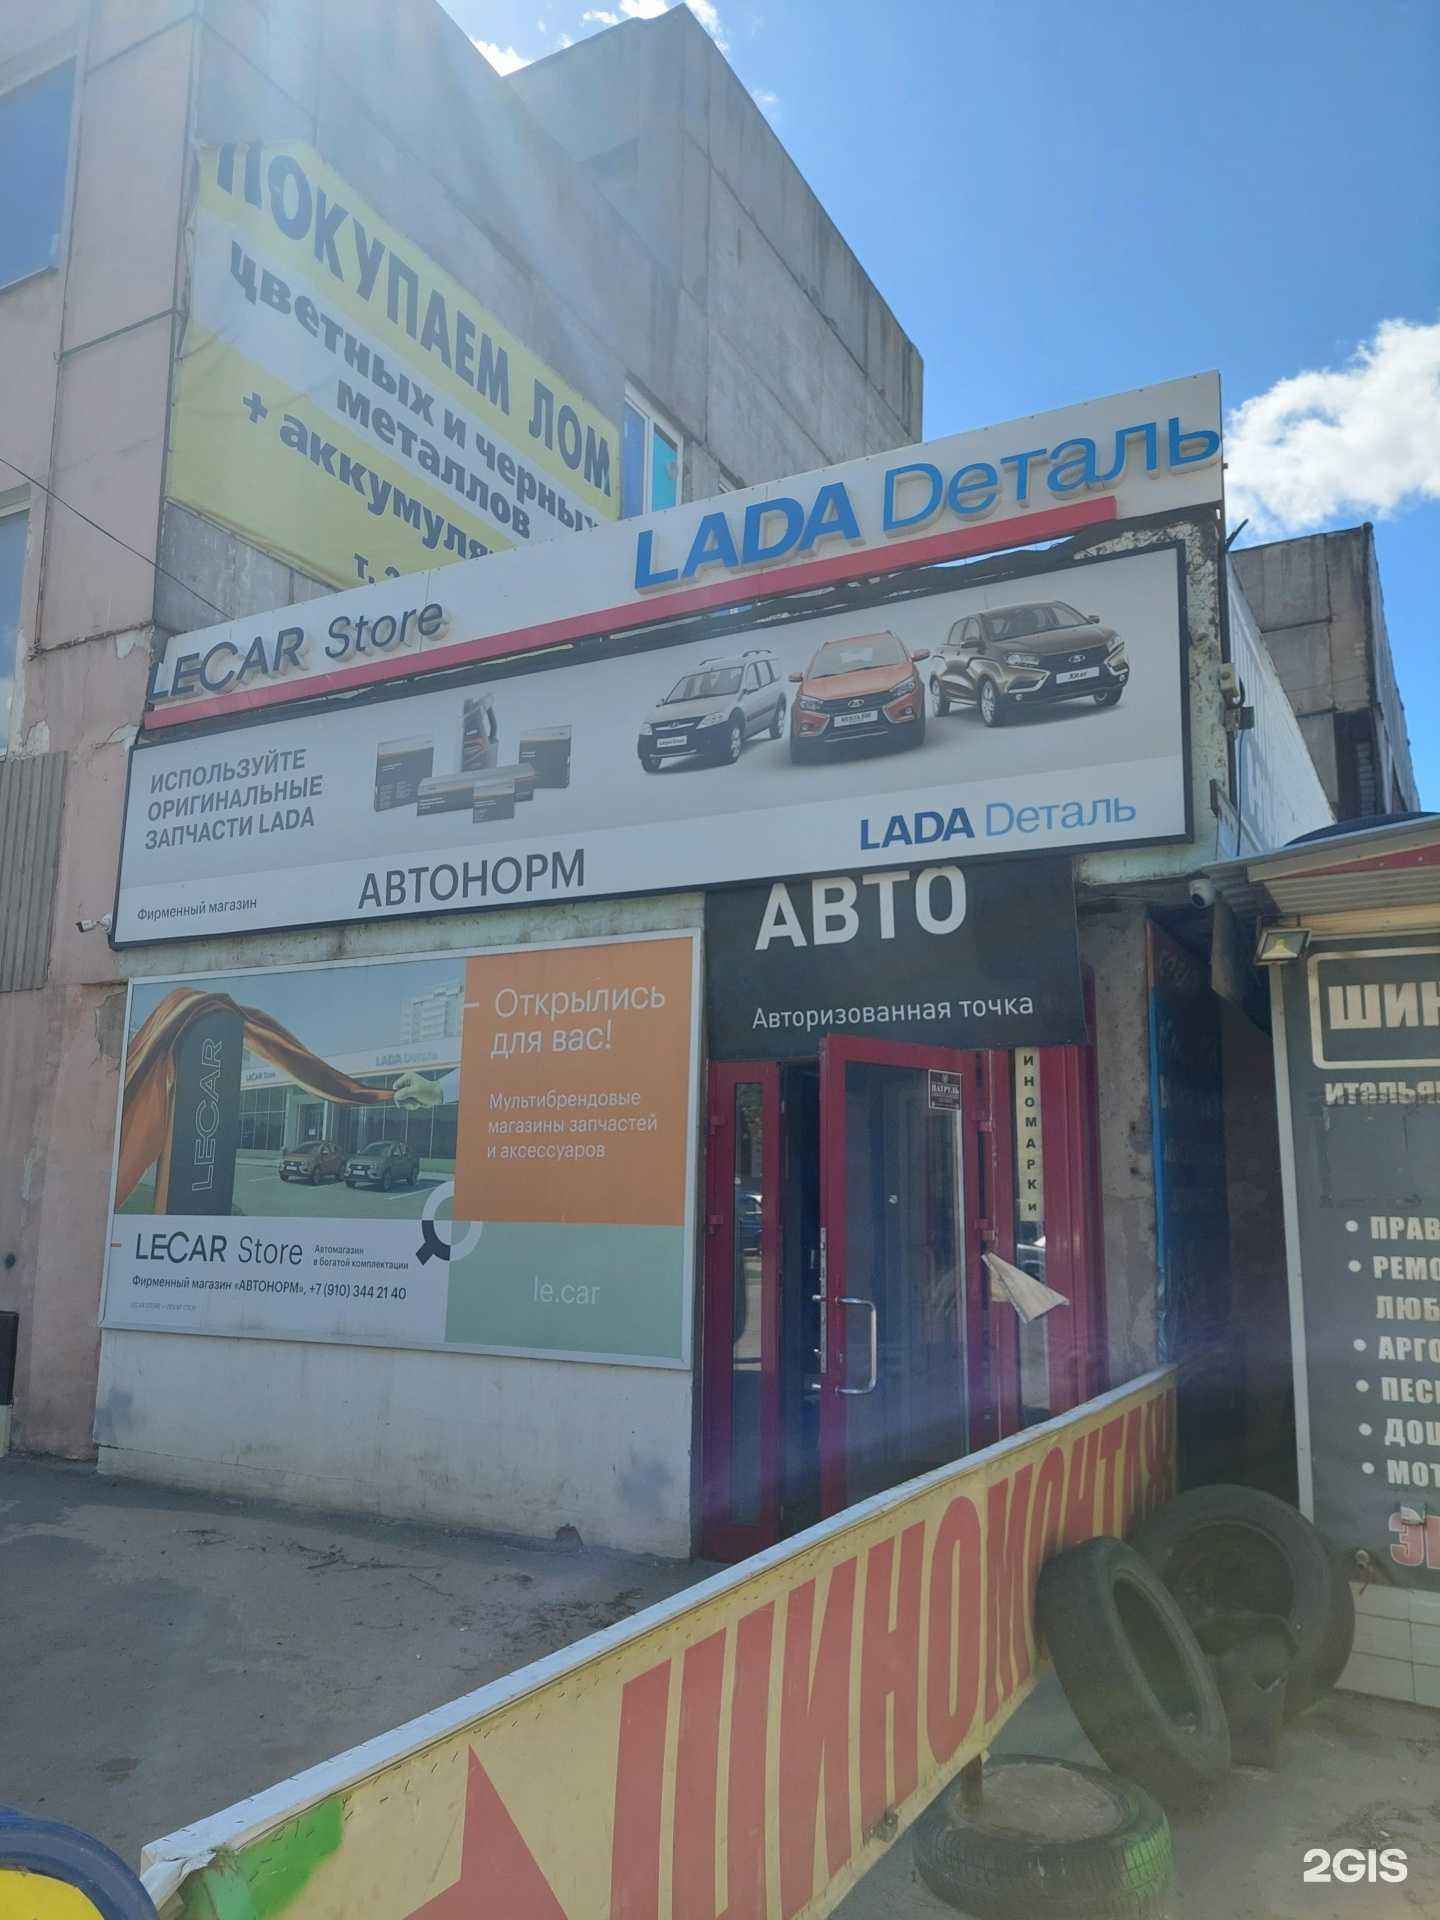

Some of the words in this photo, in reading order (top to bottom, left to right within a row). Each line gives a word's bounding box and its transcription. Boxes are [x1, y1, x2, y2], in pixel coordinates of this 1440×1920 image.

[216, 142, 510, 416] ПОКУПАЕМ
[529, 379, 611, 497] ЛОМ
[231, 240, 434, 426] цветных
[444, 409, 466, 449] и
[337, 379, 530, 538] металлов
[633, 481, 861, 591] LADA
[148, 626, 305, 700] LECAR
[325, 602, 444, 660] Store
[150, 749, 306, 794] ИСПОЛЬЗУЙТЕ
[147, 774, 324, 821] ОРИГИНАЛЬНЫЕ
[145, 815, 253, 849] ЗАПЧАСТИ
[259, 806, 315, 834] LADA
[860, 808, 976, 850] LADA
[358, 848, 585, 909] АВТОНОРМ
[137, 900, 207, 922] Фирменный
[208, 898, 257, 914] магазин
[754, 865, 967, 950] АВТО
[495, 986, 666, 1022] Открылись
[752, 1001, 951, 1032] Авторизованная
[958, 996, 1034, 1018] точка
[490, 1030, 543, 1059] для
[552, 1019, 613, 1052] вас!
[192, 1038, 223, 1191] LECAR
[489, 1090, 641, 1112] Мультибрендовые
[488, 1118, 564, 1134] магазины
[569, 1113, 657, 1132] запчастей
[487, 1144, 496, 1158] и
[501, 1144, 605, 1160] аксессуаров
[135, 1231, 227, 1263] LECAR
[238, 1235, 303, 1265] Store
[314, 1244, 364, 1254] Автомагазин
[319, 1257, 350, 1268] богатой
[352, 1260, 409, 1270] комплектации
[132, 1274, 190, 1290] Фирменный
[192, 1278, 232, 1291] магазин
[309, 1284, 321, 1295] +7
[323, 1283, 351, 1297] (910)
[352, 1285, 374, 1298] 344
[376, 1286, 388, 1298] 21
[391, 1287, 407, 1300] 40
[533, 1275, 600, 1304] le.car
